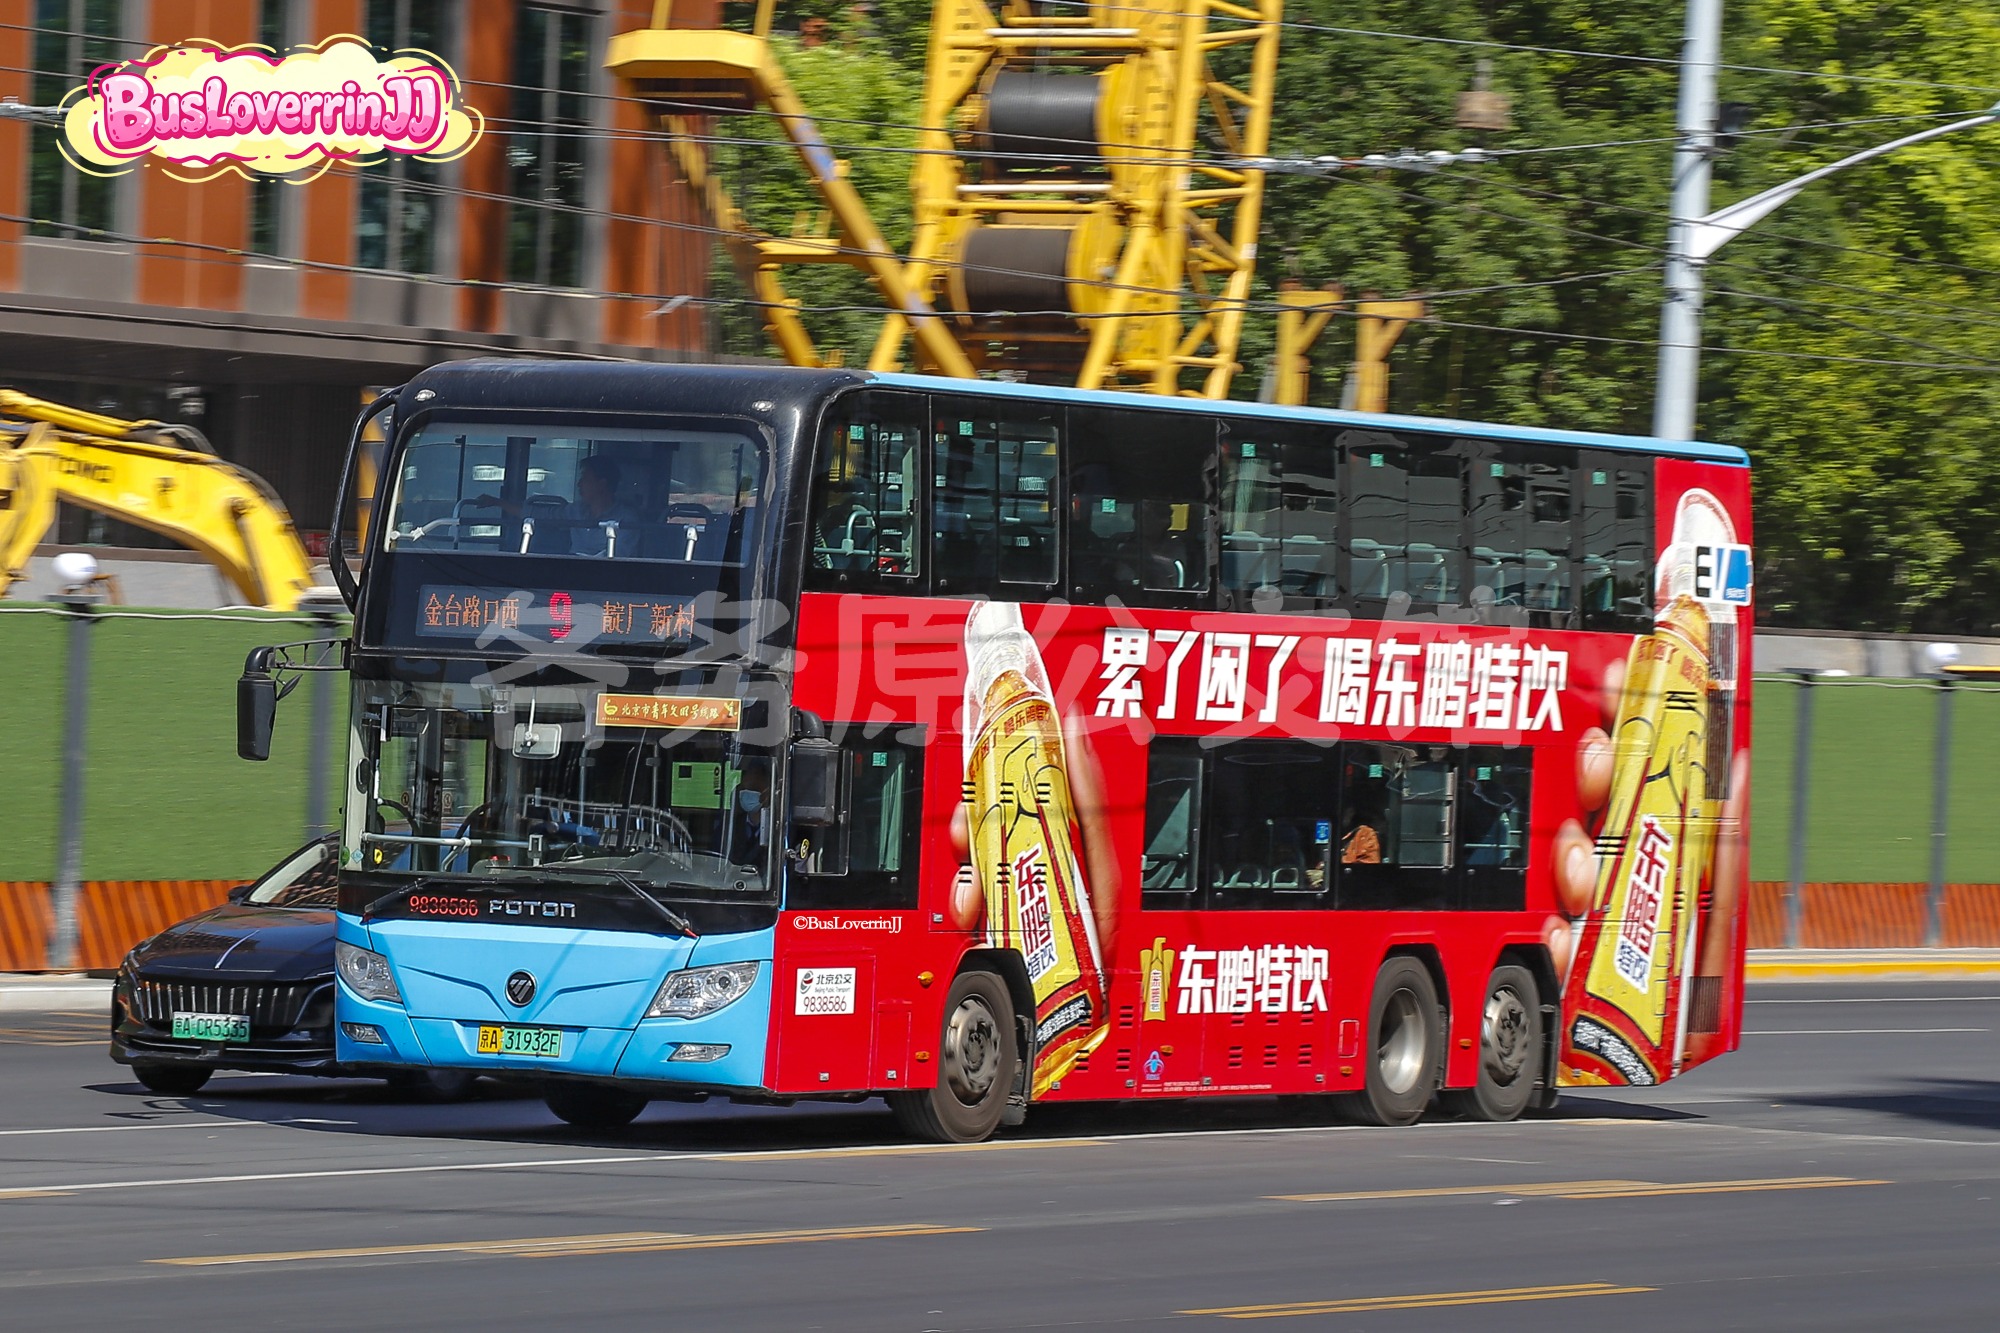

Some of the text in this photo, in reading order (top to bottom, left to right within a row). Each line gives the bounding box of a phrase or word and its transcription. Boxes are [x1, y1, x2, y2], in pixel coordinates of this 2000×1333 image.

[424, 592, 695, 638] 金台路口西 9 靛厂新村
[1093, 627, 1568, 733] 累了困了 喝东鹏特饮
[621, 702, 719, 719] 北京市青年文明号线路
[410, 895, 576, 917] 9838586 FOTON
[816, 974, 852, 985] 北京公交
[1177, 944, 1329, 1014] 东鹏特饮
[804, 995, 847, 1012] 9838586
